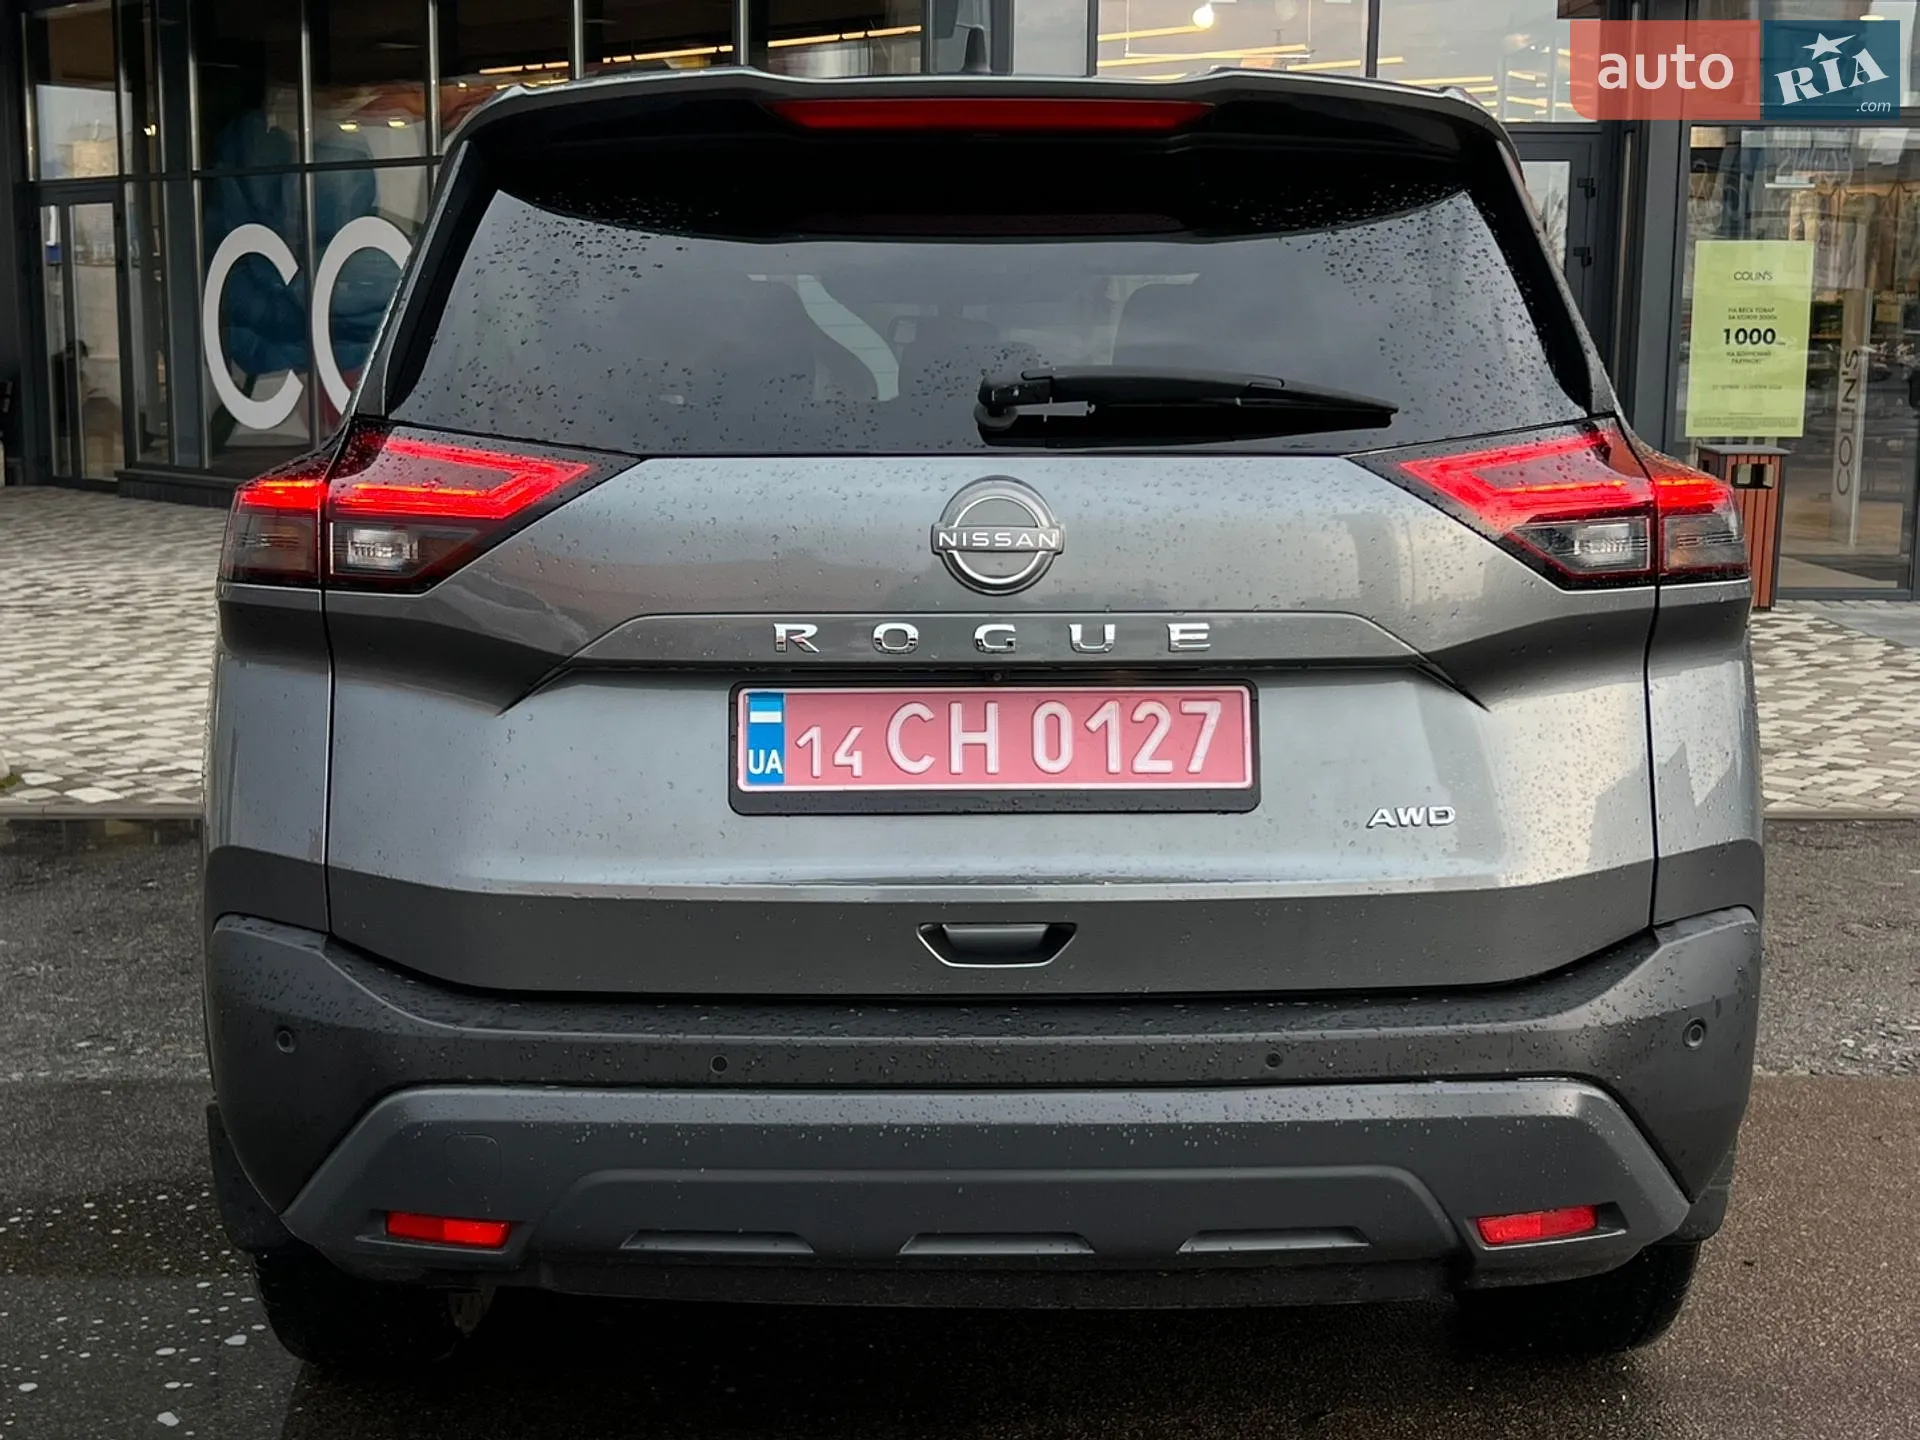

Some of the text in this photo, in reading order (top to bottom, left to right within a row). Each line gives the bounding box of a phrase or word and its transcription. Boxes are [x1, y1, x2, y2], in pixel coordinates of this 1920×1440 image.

[1723, 327, 1777, 345] 1000
[938, 530, 1060, 549] NISSAN
[773, 622, 1212, 654] ROGUE
[795, 700, 1223, 778] 14 CH 0127
[748, 748, 784, 775] UA
[1365, 806, 1456, 829] AWD
